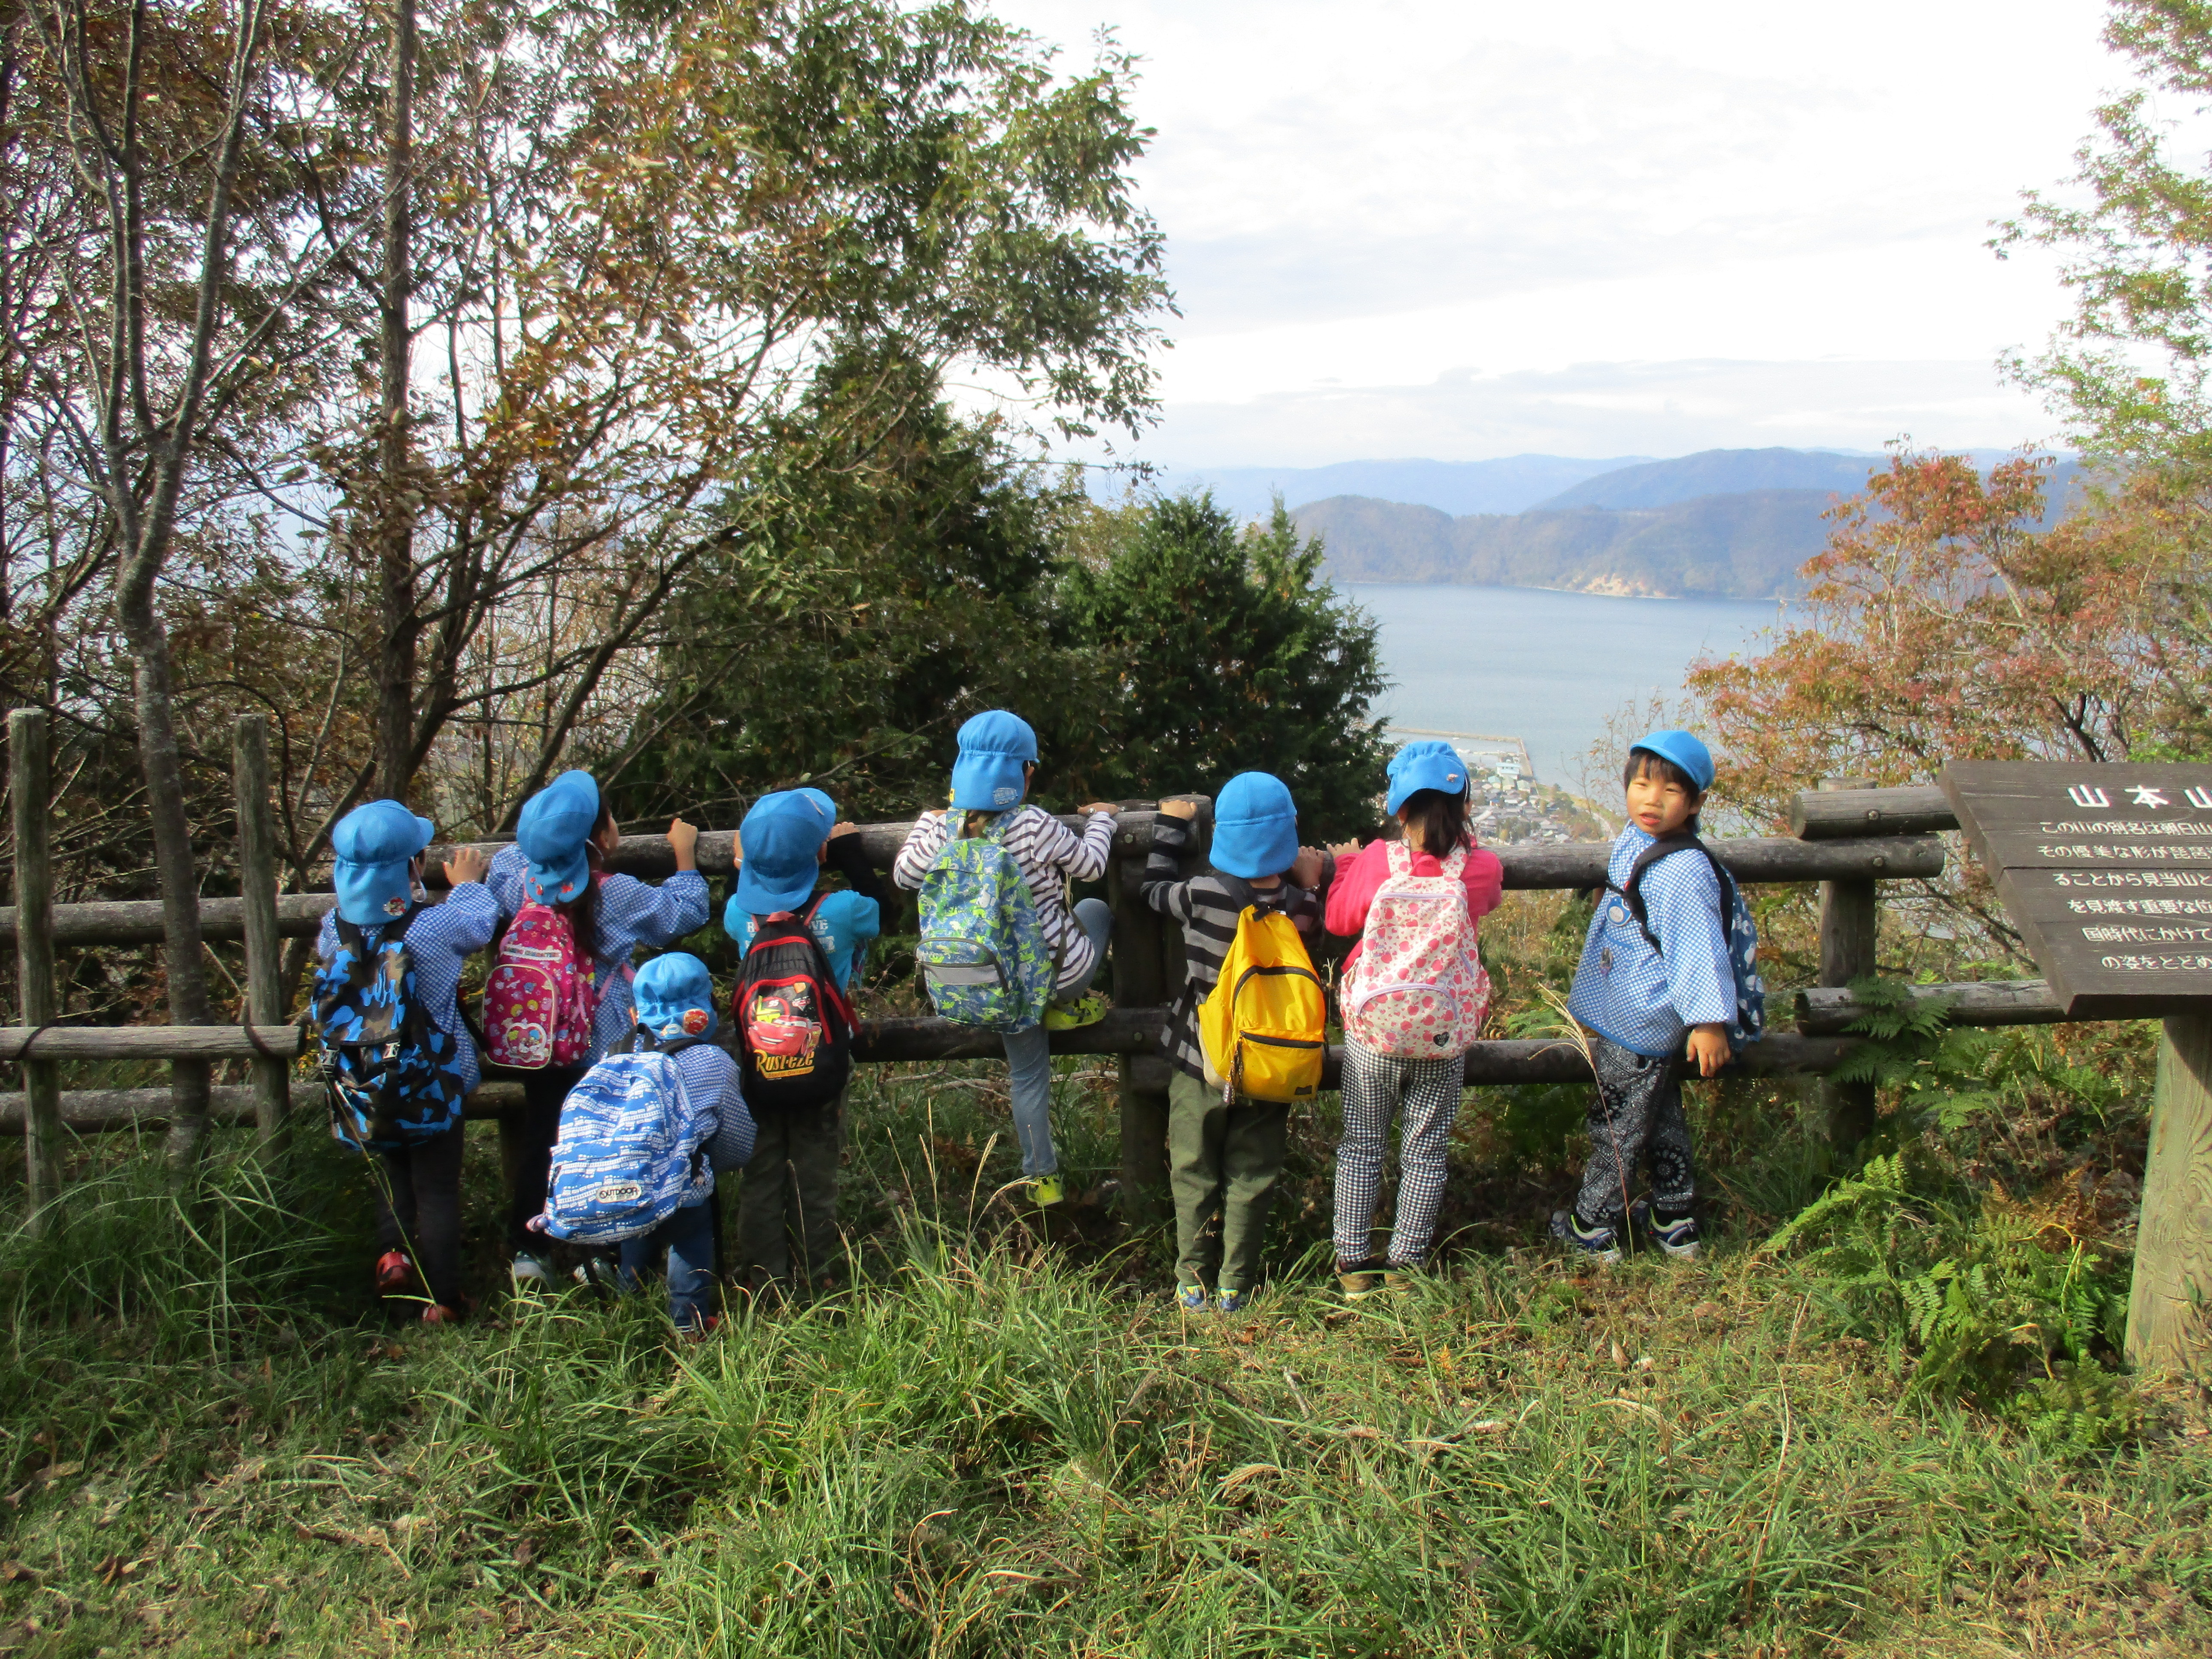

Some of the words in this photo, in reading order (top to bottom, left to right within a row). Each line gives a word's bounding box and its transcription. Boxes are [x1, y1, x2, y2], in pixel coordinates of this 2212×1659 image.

[2039, 821, 2212, 835] この山の別名は朝日山
[2037, 845, 2212, 859] その優美な形が琵琶
[2052, 872, 2212, 887] ることから見当山と
[2067, 899, 2212, 914] を見渡す重要な位
[2081, 927, 2212, 942] 国時代にかけて
[2101, 955, 2212, 970] の姿をとどめ
[768, 999, 779, 1007] 95
[599, 1187, 638, 1199] OUTDOOR
